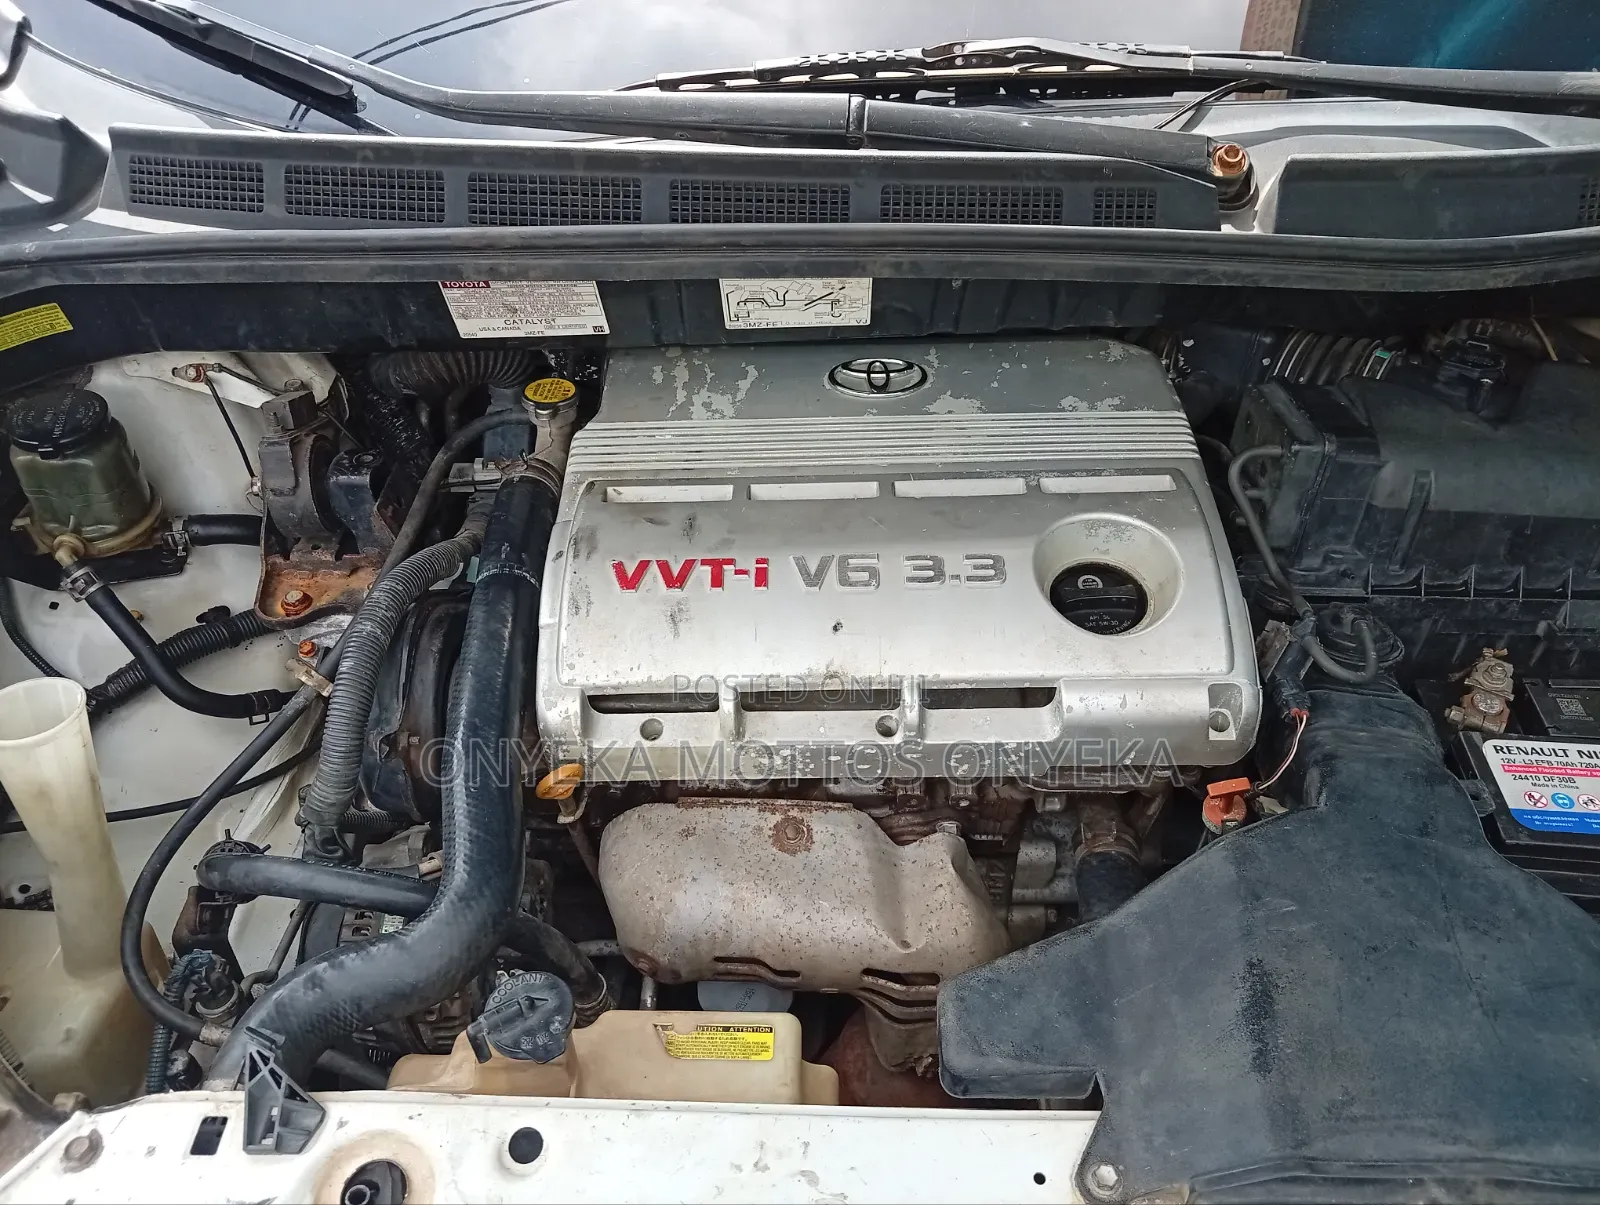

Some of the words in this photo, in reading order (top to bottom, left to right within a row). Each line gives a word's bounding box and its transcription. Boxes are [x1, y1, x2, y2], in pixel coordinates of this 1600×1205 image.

[612, 557, 771, 592] VVT-i
[789, 552, 881, 591] V6
[902, 553, 1007, 591] 3.3
[1492, 745, 1569, 758] RENAULT
[1576, 750, 1600, 760] NI
[1543, 775, 1577, 784] DF30B
[1566, 768, 1591, 776] Battery
[492, 973, 546, 1004] COOLANT
